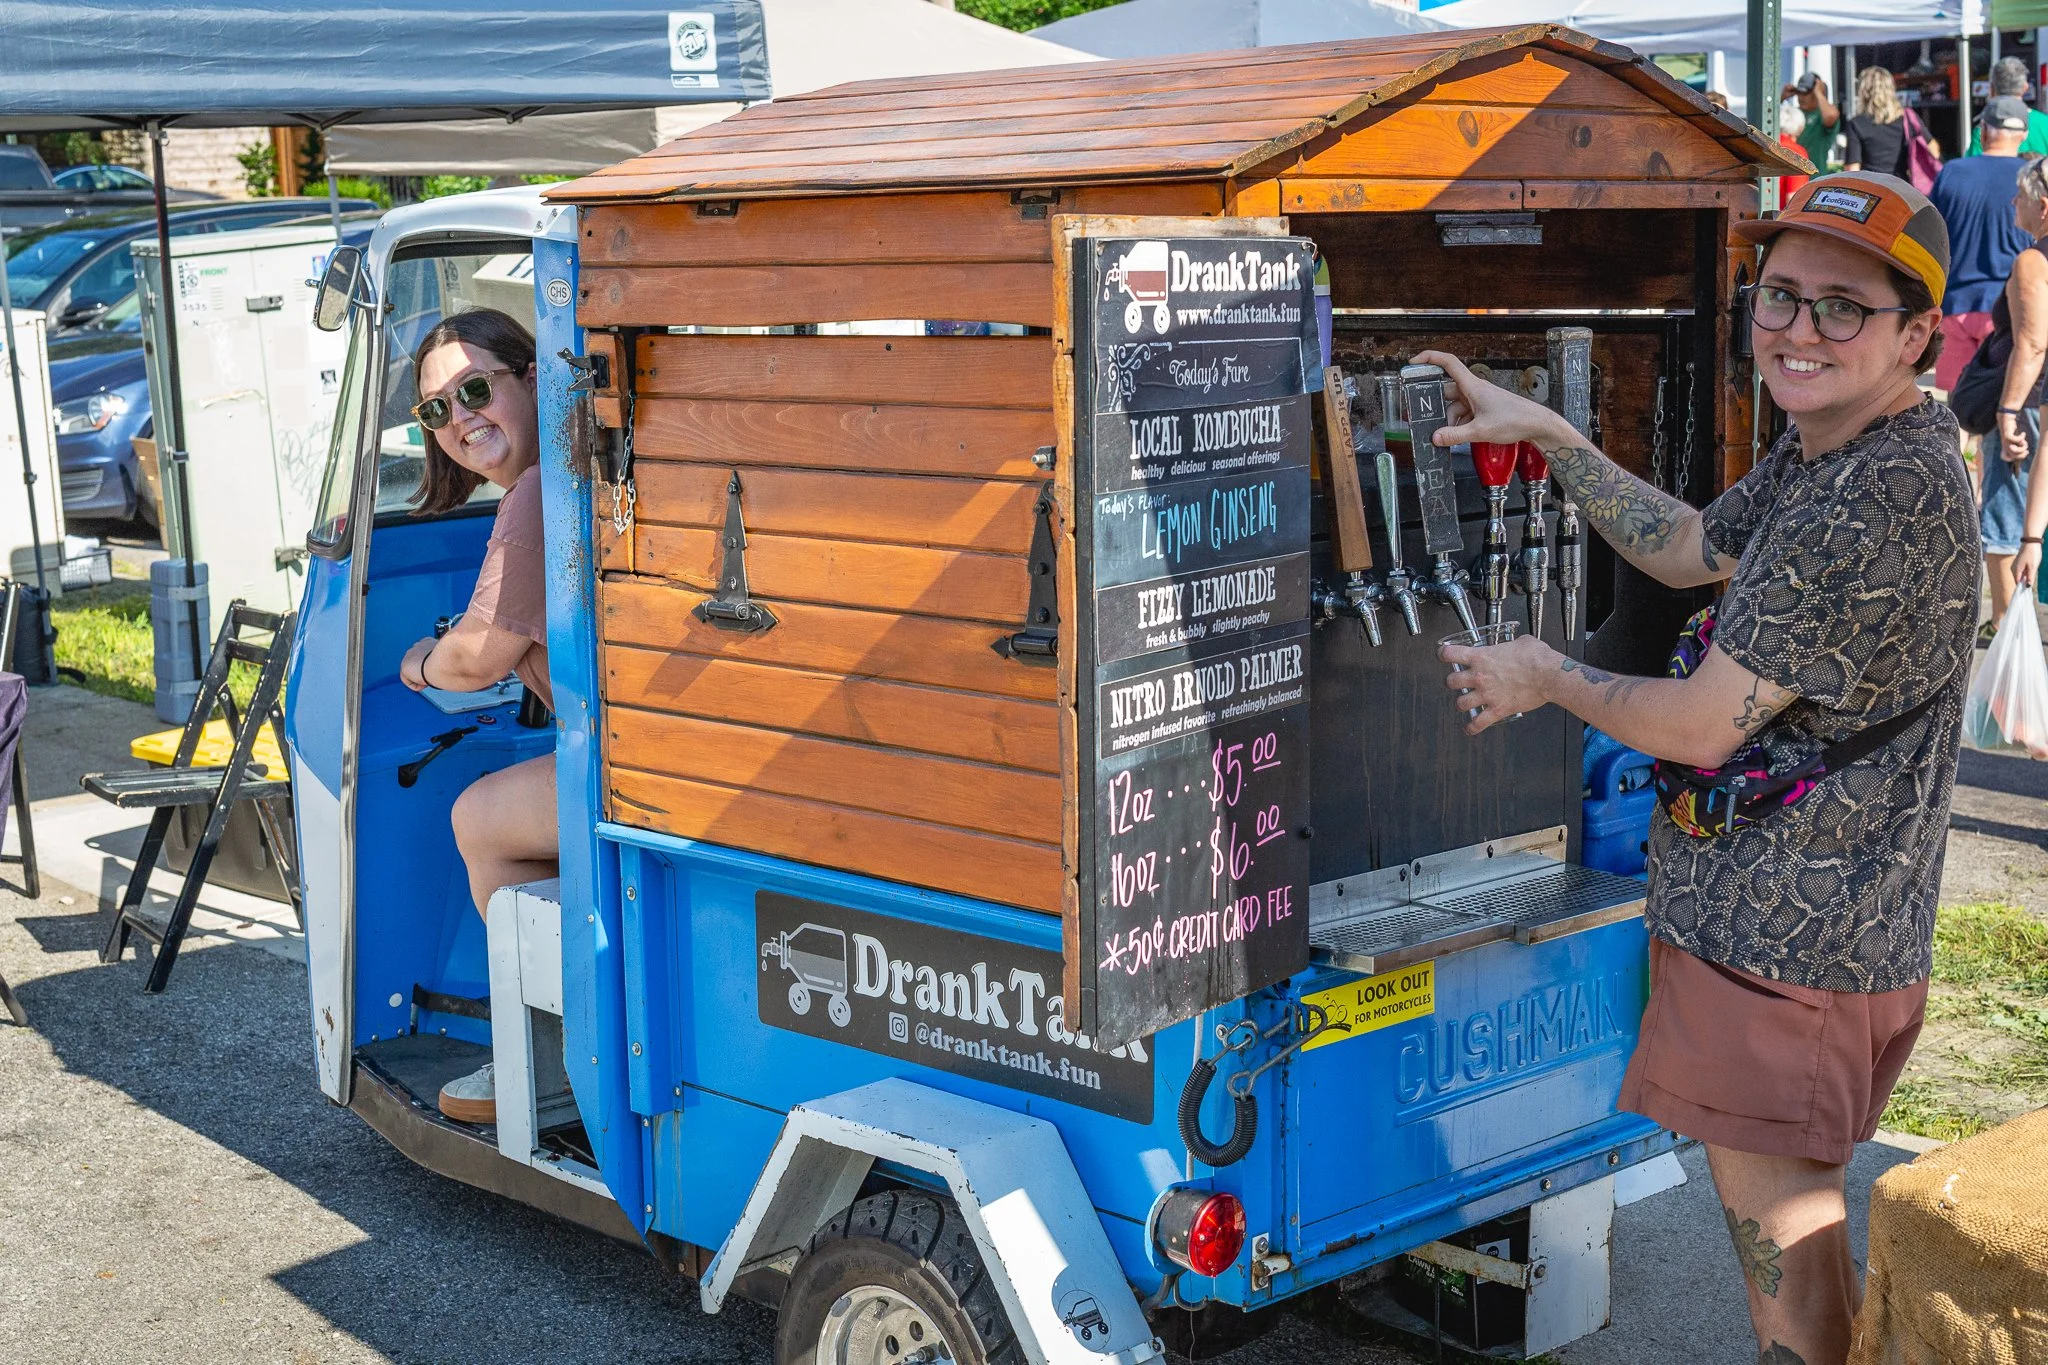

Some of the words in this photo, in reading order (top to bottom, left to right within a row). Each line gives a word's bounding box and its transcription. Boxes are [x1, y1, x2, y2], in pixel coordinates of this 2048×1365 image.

[1826, 197, 1859, 208] cotopaxi
[200, 267, 228, 276] FRONT
[1170, 250, 1301, 292] DrankTank
[550, 285, 568, 299] CHS
[1176, 302, 1301, 326] www.dranktank.fun
[1169, 357, 1219, 394] Today's
[1222, 354, 1251, 387] Fare
[1332, 372, 1343, 395] UP
[1419, 395, 1433, 412] N
[1129, 415, 1182, 460] LOCAL
[1192, 404, 1282, 453] KOMBUCHA
[1130, 465, 1165, 481] healthy
[1170, 459, 1207, 476] delicious
[1212, 453, 1246, 471] seasonal
[1247, 450, 1281, 466] offerings
[1098, 494, 1134, 521] Today's
[1142, 501, 1201, 563] LEMON
[1210, 480, 1277, 551] GINSENG
[1137, 582, 1185, 629] FIZZY
[1191, 566, 1276, 618] LEMONADE
[1145, 633, 1168, 648] fresh
[1169, 632, 1177, 642] &
[1177, 624, 1207, 641] bubbly
[1212, 617, 1242, 634] slightly
[1242, 610, 1271, 628] peachy
[1110, 678, 1166, 729] NITRO
[1171, 660, 1236, 712] ARNOLD
[1240, 644, 1304, 693] PALMER
[1112, 730, 1150, 751] nitrogen
[1151, 722, 1182, 740] infused
[1183, 711, 1217, 730] favorite
[1221, 697, 1267, 720] refreshingly
[1268, 685, 1303, 705] balanced
[1169, 910, 1219, 959] CREDIT
[1223, 895, 1261, 943] CARD
[1268, 885, 1293, 928] FEE
[852, 933, 1149, 1064] DrankTa
[1357, 979, 1398, 1006] LOOK
[1400, 970, 1430, 993] OUT
[1354, 1011, 1372, 1025] FOR
[1373, 993, 1432, 1020] MOTORCYCLES
[914, 1022, 1101, 1090] @dranktank.fun
[1394, 972, 1622, 1104] CUSHMAN
